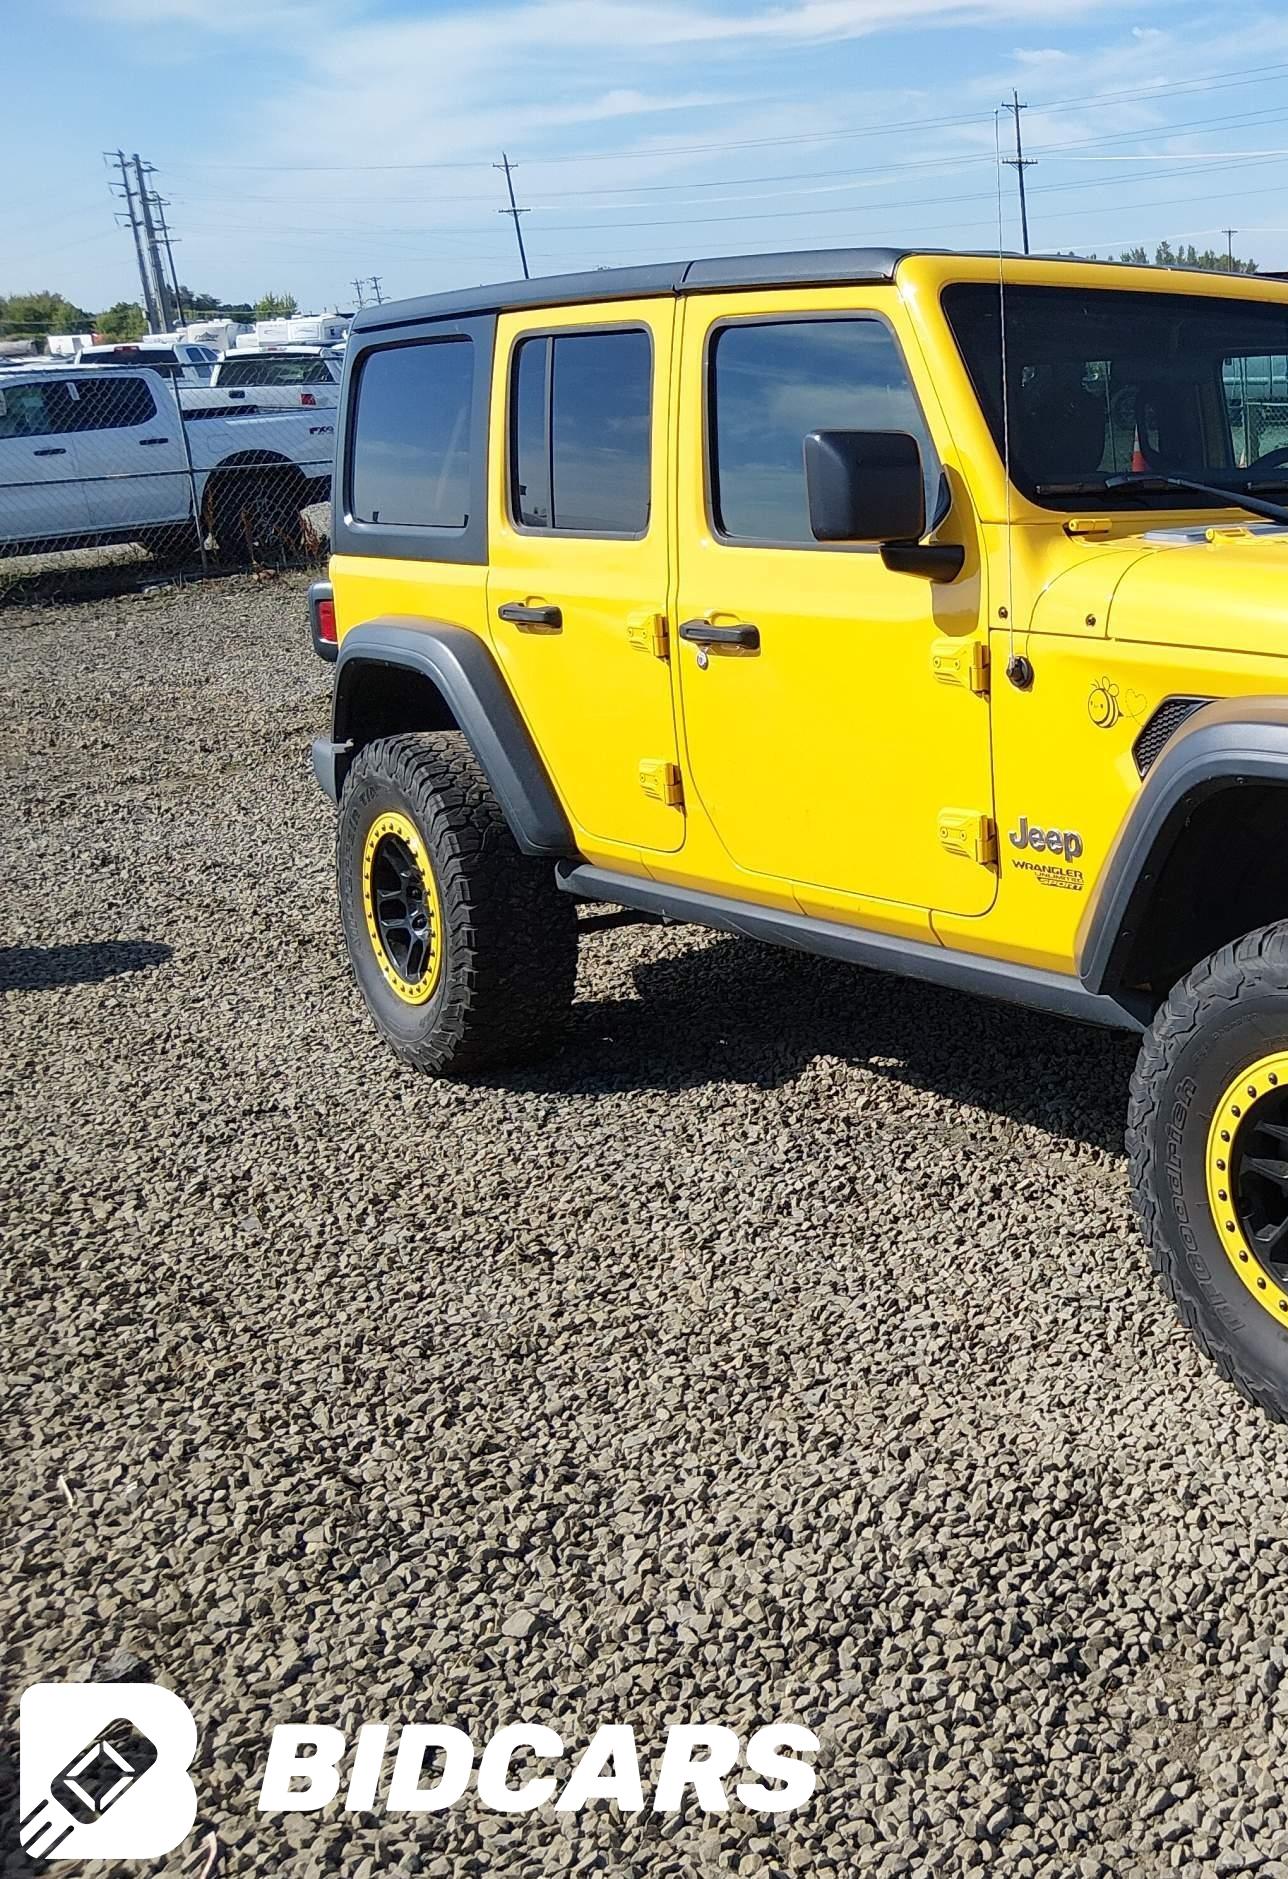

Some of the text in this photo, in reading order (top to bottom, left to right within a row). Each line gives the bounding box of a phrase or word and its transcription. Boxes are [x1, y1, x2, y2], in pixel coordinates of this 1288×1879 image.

[1008, 817, 1083, 863] Jeep
[1012, 859, 1084, 880] WRANGLER
[1038, 877, 1083, 891] SPORT
